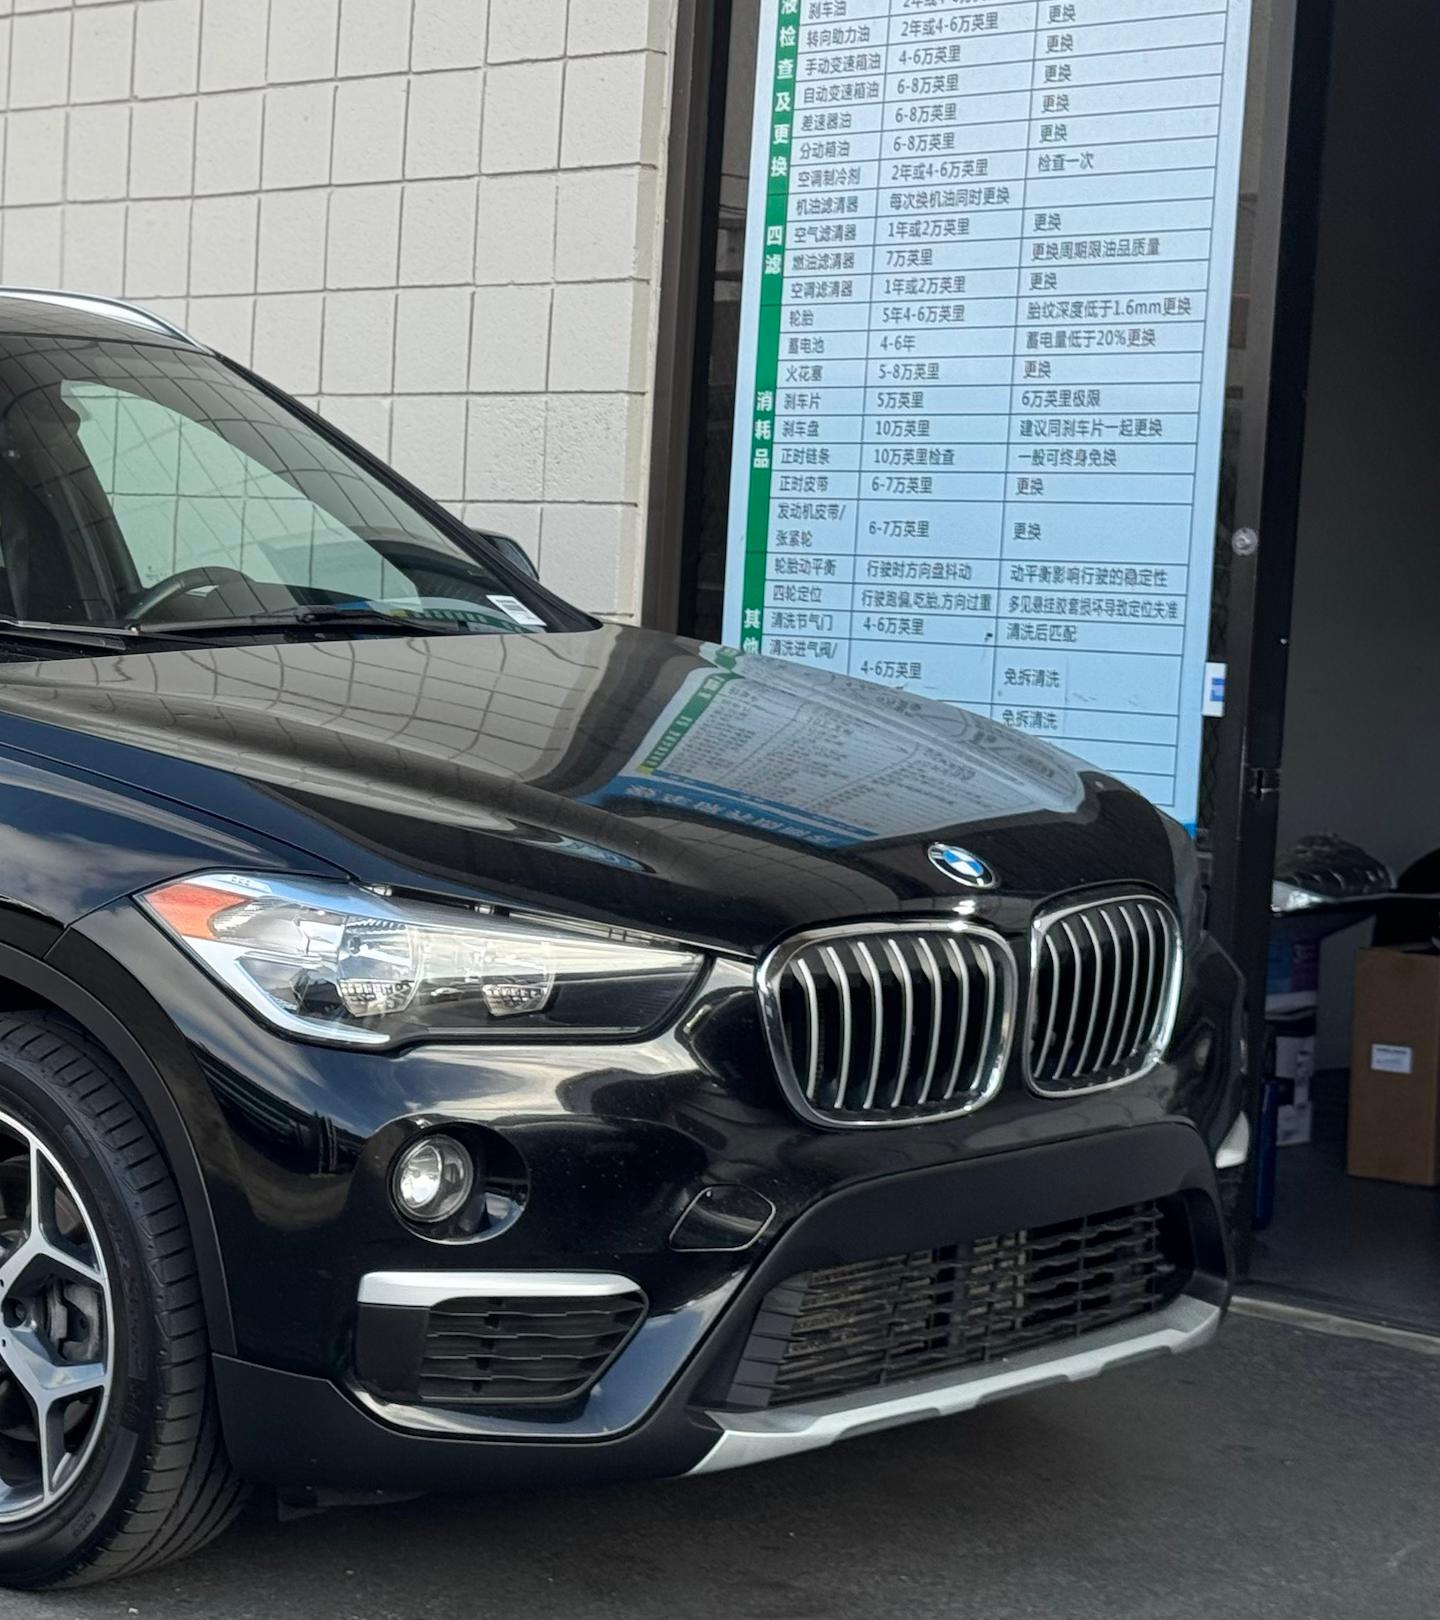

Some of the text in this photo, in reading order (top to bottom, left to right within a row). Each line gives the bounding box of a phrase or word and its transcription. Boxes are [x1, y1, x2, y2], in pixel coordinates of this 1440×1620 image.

[808, 0, 847, 20] 刹车油
[1048, 4, 1076, 25] 更换
[900, 11, 999, 37] 2年或4-6万英里
[806, 24, 870, 48] 转向助力油
[1045, 34, 1074, 54] 更换
[804, 52, 881, 76] 手动变速箱油
[898, 44, 961, 65] 4-6万英里
[896, 73, 959, 95] 6-8万英里
[1043, 64, 1072, 84] 更换
[803, 81, 880, 104] 自动变速箱油
[895, 102, 957, 123] 6-8万英里
[1041, 93, 1070, 114] 更换
[800, 111, 852, 132] 差速器油
[893, 131, 955, 152] 6-8万英里
[1039, 123, 1068, 144] 更换
[800, 140, 850, 160] 分动箱油
[891, 158, 989, 181] 2年或4-6万英里
[1038, 150, 1095, 173] 检查一次
[796, 195, 858, 216] 机油滤清器
[889, 186, 1010, 211] 每次换机油同时更换
[887, 217, 970, 239] 1年或2万英里
[1033, 212, 1062, 232] 更换
[794, 223, 857, 243] 空气滤清器
[886, 248, 933, 267] 7万英里
[790, 280, 853, 299] 空调滤清器
[884, 275, 966, 296] 1年或2万英里
[1028, 271, 1057, 291] 更换
[789, 309, 814, 327] 轮胎
[882, 304, 965, 324] 5年4-6万英里
[1026, 296, 1192, 321] 胎纹深度低于1.6mm更换
[787, 336, 825, 354] 蓄电池
[879, 335, 916, 352] 4-6年
[1026, 328, 1157, 350] 蓄电量低于20%更换
[785, 364, 824, 382] 火花塞
[878, 362, 940, 380] 5-8万英里
[1023, 360, 1052, 380] 更换
[783, 392, 822, 410] 刹车片
[877, 391, 924, 409] 5万英里
[1021, 389, 1101, 408] 6万英里极限
[781, 419, 819, 437] 刹车盘
[875, 419, 930, 438] 10万英里
[1019, 418, 1163, 438] 建议同刹车片一起更换
[780, 447, 830, 465] 正时链条
[873, 447, 955, 466] 10万英里检查
[1018, 448, 1117, 468] 一般可终身免换
[779, 475, 829, 493] 正时皮带
[871, 476, 933, 494] 6-7万英里
[1015, 477, 1044, 496] 更换
[775, 530, 813, 547] 张紧轮
[868, 520, 930, 538] 6-7万英里
[1012, 522, 1042, 541] 更换
[774, 557, 837, 576] 轮胎动平衡
[867, 560, 973, 581] 行驶时方向盘抖动
[1010, 564, 1169, 588] 动平衡影响行驶的稳定性
[772, 584, 823, 603] 四轮定位
[770, 611, 834, 631] 清洗节气门
[863, 616, 925, 636] 4-6万英里
[1006, 622, 1078, 643] 清洗后匹配
[860, 660, 922, 680] 4-6万英里
[1003, 667, 1061, 688] 免拆清洗
[1001, 709, 1059, 730] 免拆清洗
